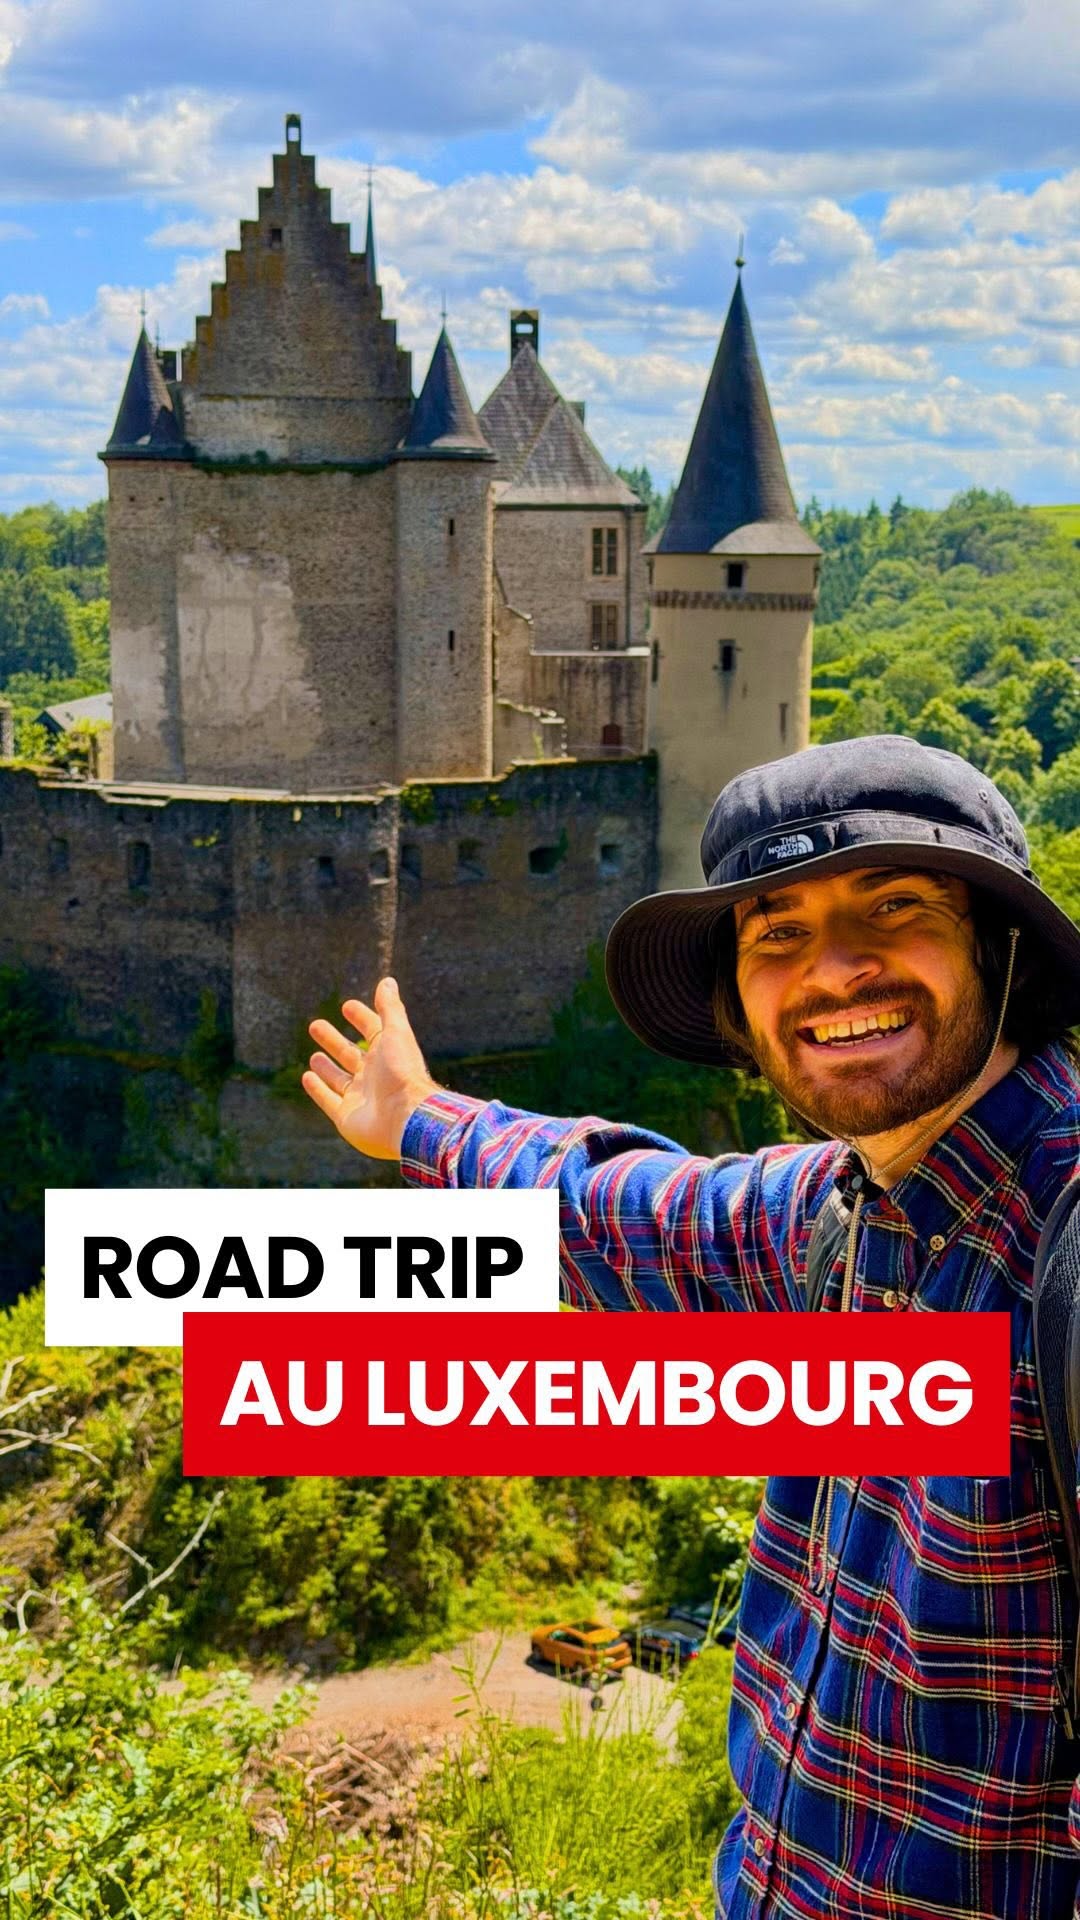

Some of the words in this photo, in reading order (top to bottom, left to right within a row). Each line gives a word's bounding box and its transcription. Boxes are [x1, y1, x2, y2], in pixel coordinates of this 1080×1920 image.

[780, 835, 797, 845] THE
[768, 842, 798, 855] NORTH
[777, 849, 798, 859] FACE
